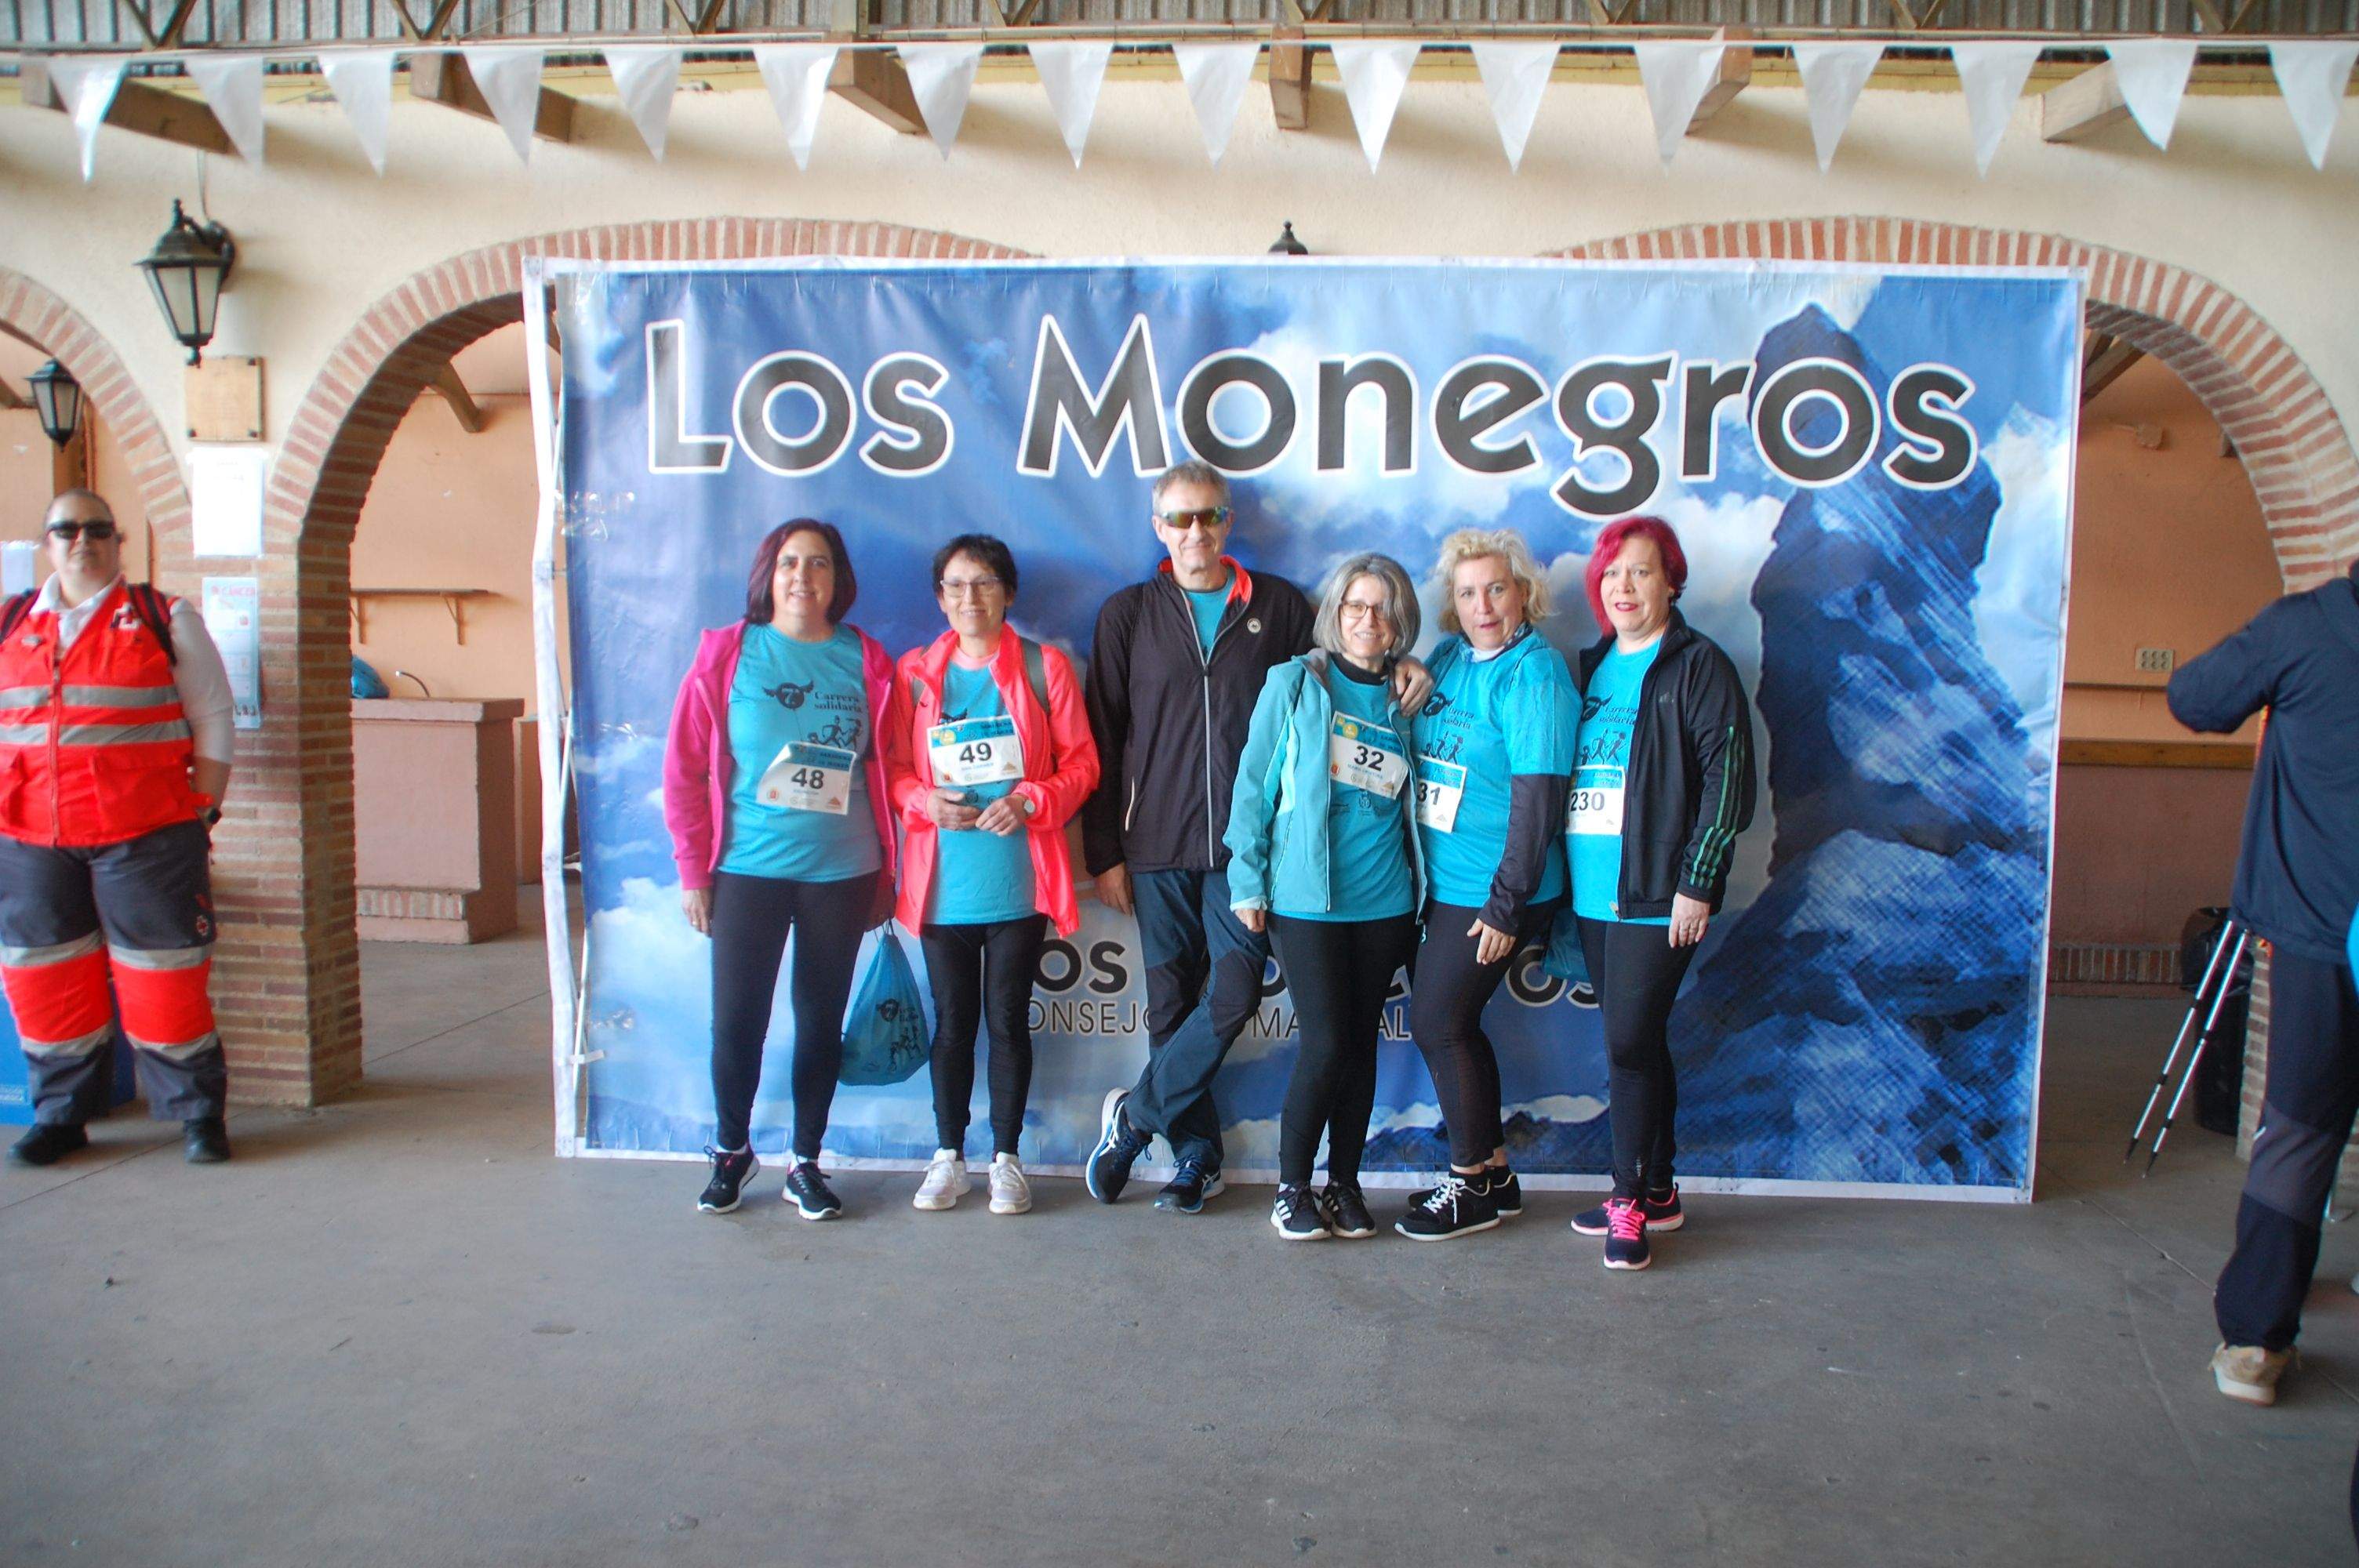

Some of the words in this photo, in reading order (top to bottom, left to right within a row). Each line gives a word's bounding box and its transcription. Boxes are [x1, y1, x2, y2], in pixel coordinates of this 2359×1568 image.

[647, 320, 953, 477] Los
[1018, 314, 1977, 521] Monegros
[959, 742, 992, 763] 49
[1354, 746, 1384, 771] 32
[791, 768, 824, 789] 48
[1417, 782, 1441, 805] 31
[1570, 792, 1605, 812] 230
[1032, 938, 1128, 993] os
[1028, 1000, 1150, 1035] ONSEJ
